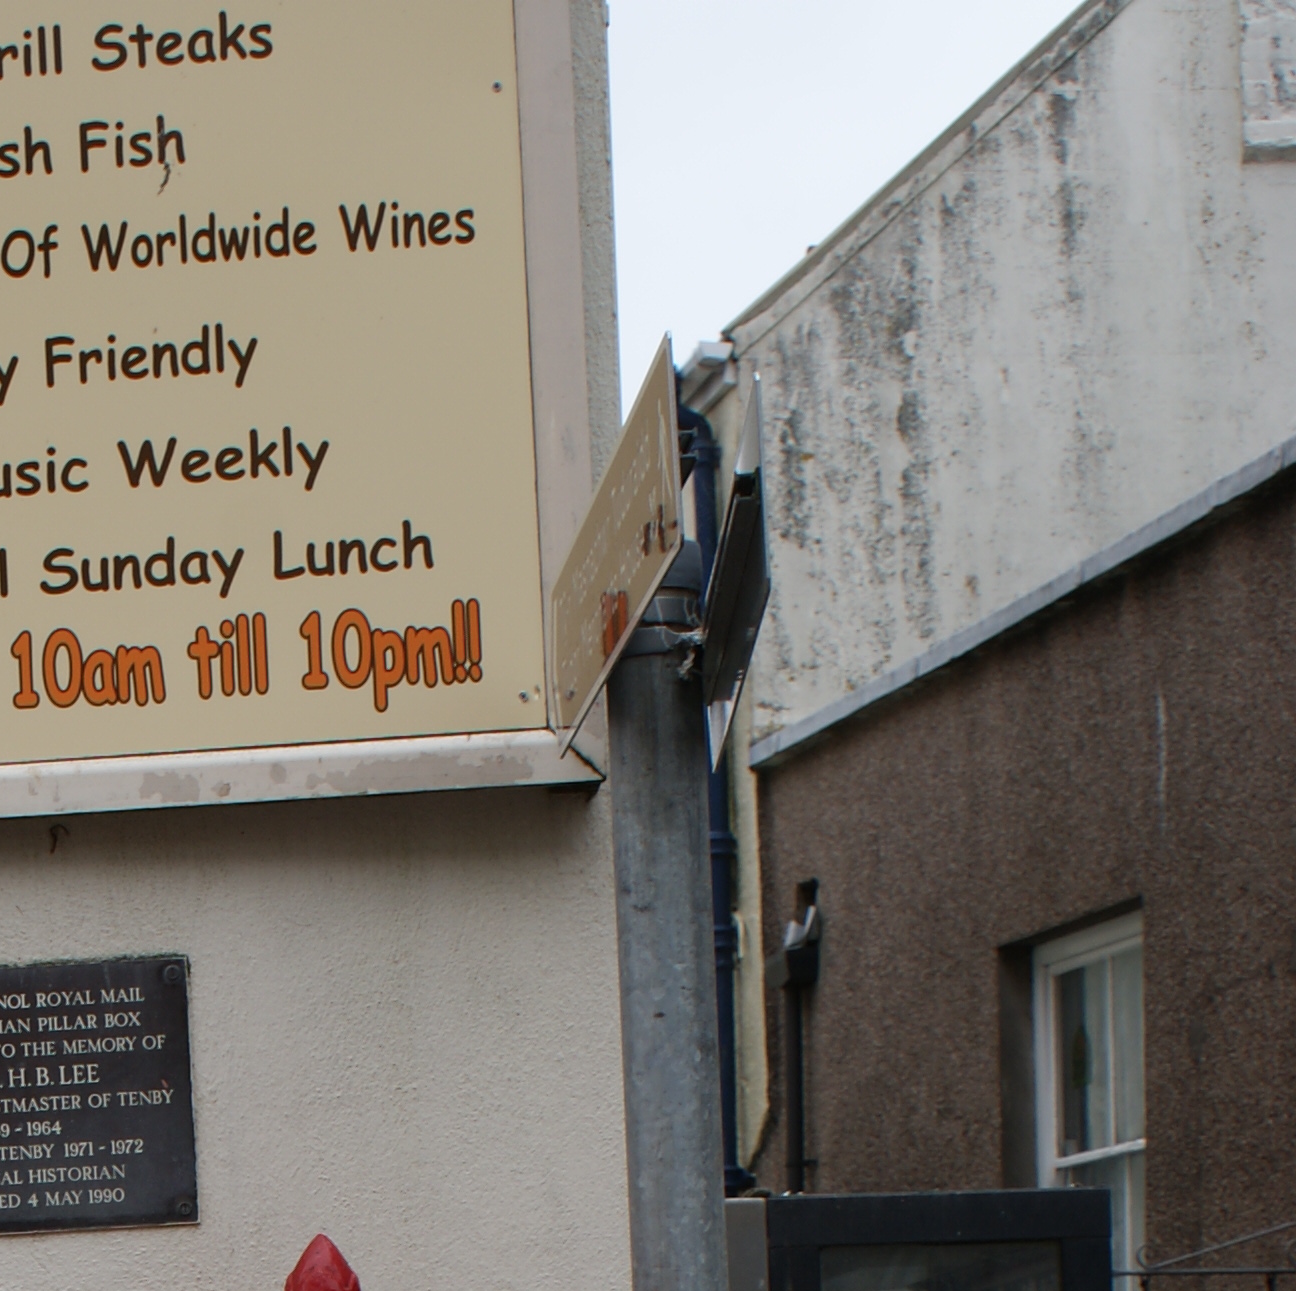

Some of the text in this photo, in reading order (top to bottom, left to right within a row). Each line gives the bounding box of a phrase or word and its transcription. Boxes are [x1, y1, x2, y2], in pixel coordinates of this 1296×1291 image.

[91, 11, 273, 72] Steaks
[79, 115, 186, 175] Fish
[0, 225, 58, 279] Of
[80, 207, 317, 272] Worldwide
[338, 202, 475, 252] Wines
[44, 323, 258, 389] Friendly
[117, 426, 329, 492] Weekly
[40, 536, 244, 599] Sunday
[273, 520, 434, 580] Lunch
[11, 631, 165, 709] 10am
[188, 613, 269, 698] till
[300, 600, 483, 713] 10pm!!
[35, 989, 96, 1008] ROYAL
[99, 986, 146, 1004] MAIL
[37, 1013, 98, 1032] PILLAR
[104, 1011, 142, 1029] BOX
[19, 1040, 57, 1058] THE
[62, 1035, 137, 1055] MEMORY
[141, 1033, 167, 1051] OF
[7, 1067, 32, 1089] H.
[35, 1066, 55, 1087] B.
[58, 1063, 101, 1086] LEE
[87, 1092, 112, 1109] OF
[116, 1088, 174, 1107] TENBY
[26, 1120, 63, 1137] 1964
[63, 1141, 94, 1158] 1971
[110, 1138, 144, 1155] 1972
[27, 1163, 126, 1184] HISTORIAN
[27, 1192, 39, 1208] 4
[44, 1189, 83, 1207] MAY
[88, 1187, 126, 1205] 1990
